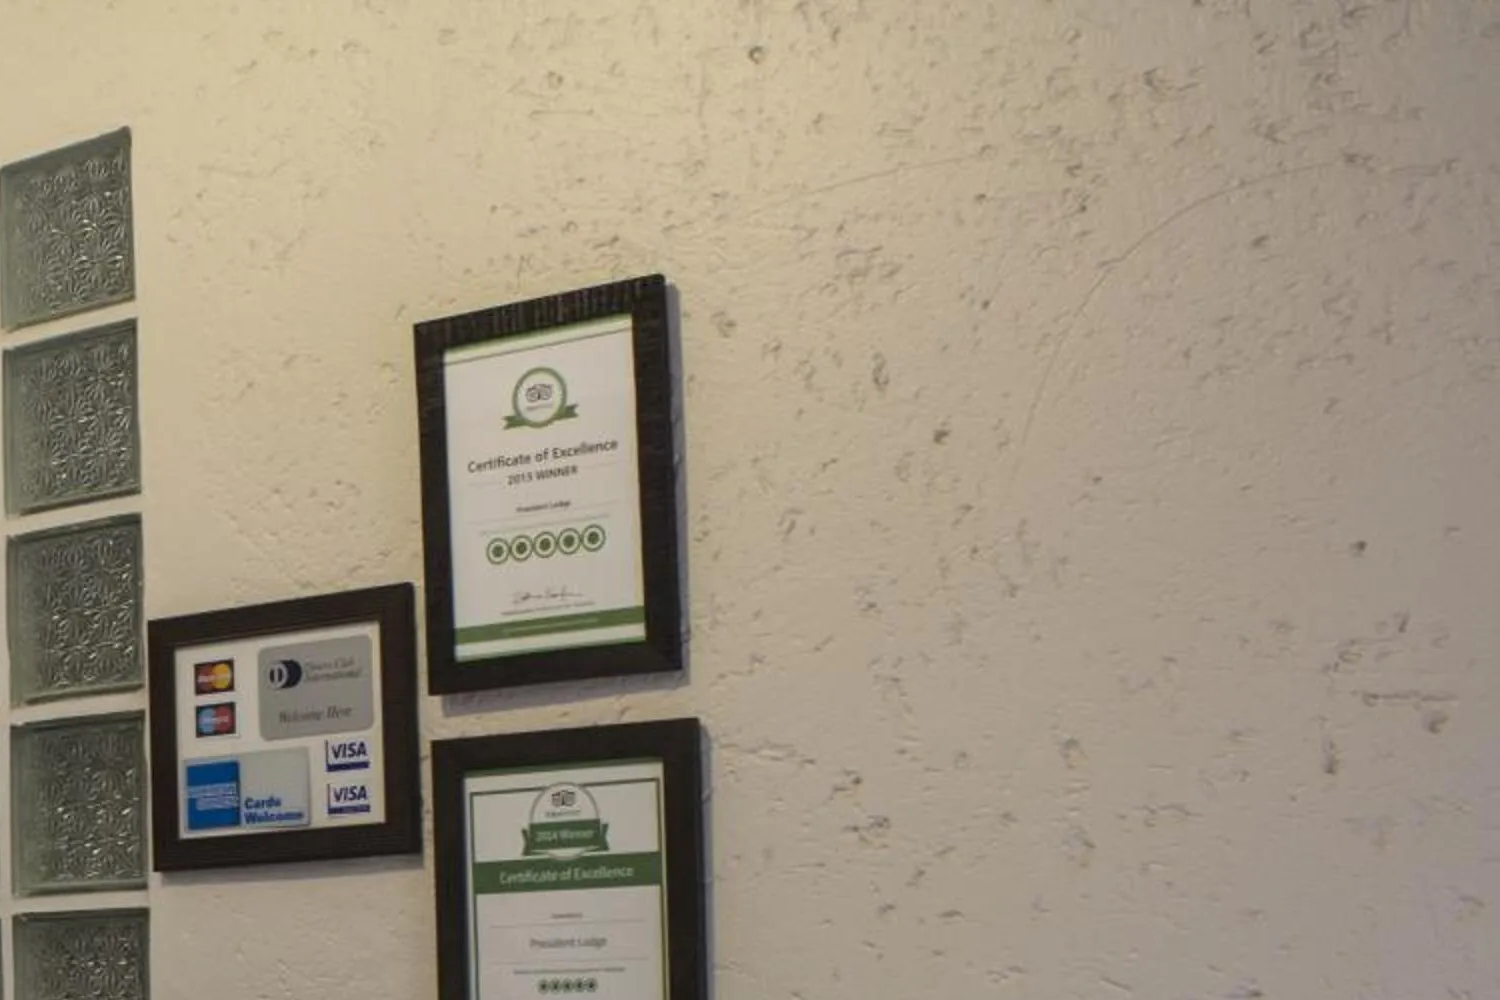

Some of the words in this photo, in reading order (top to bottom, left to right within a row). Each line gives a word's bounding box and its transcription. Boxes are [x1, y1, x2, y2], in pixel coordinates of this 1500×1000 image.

[467, 454, 531, 473] Certificate
[535, 450, 548, 463] of
[552, 440, 618, 459] Excellence
[535, 465, 578, 481] WINNER
[331, 742, 368, 759] VISA
[333, 785, 368, 802] VISA
[244, 796, 282, 809] Cards
[500, 868, 558, 885] Certificate
[560, 867, 572, 880] of
[573, 865, 635, 881] Excellence
